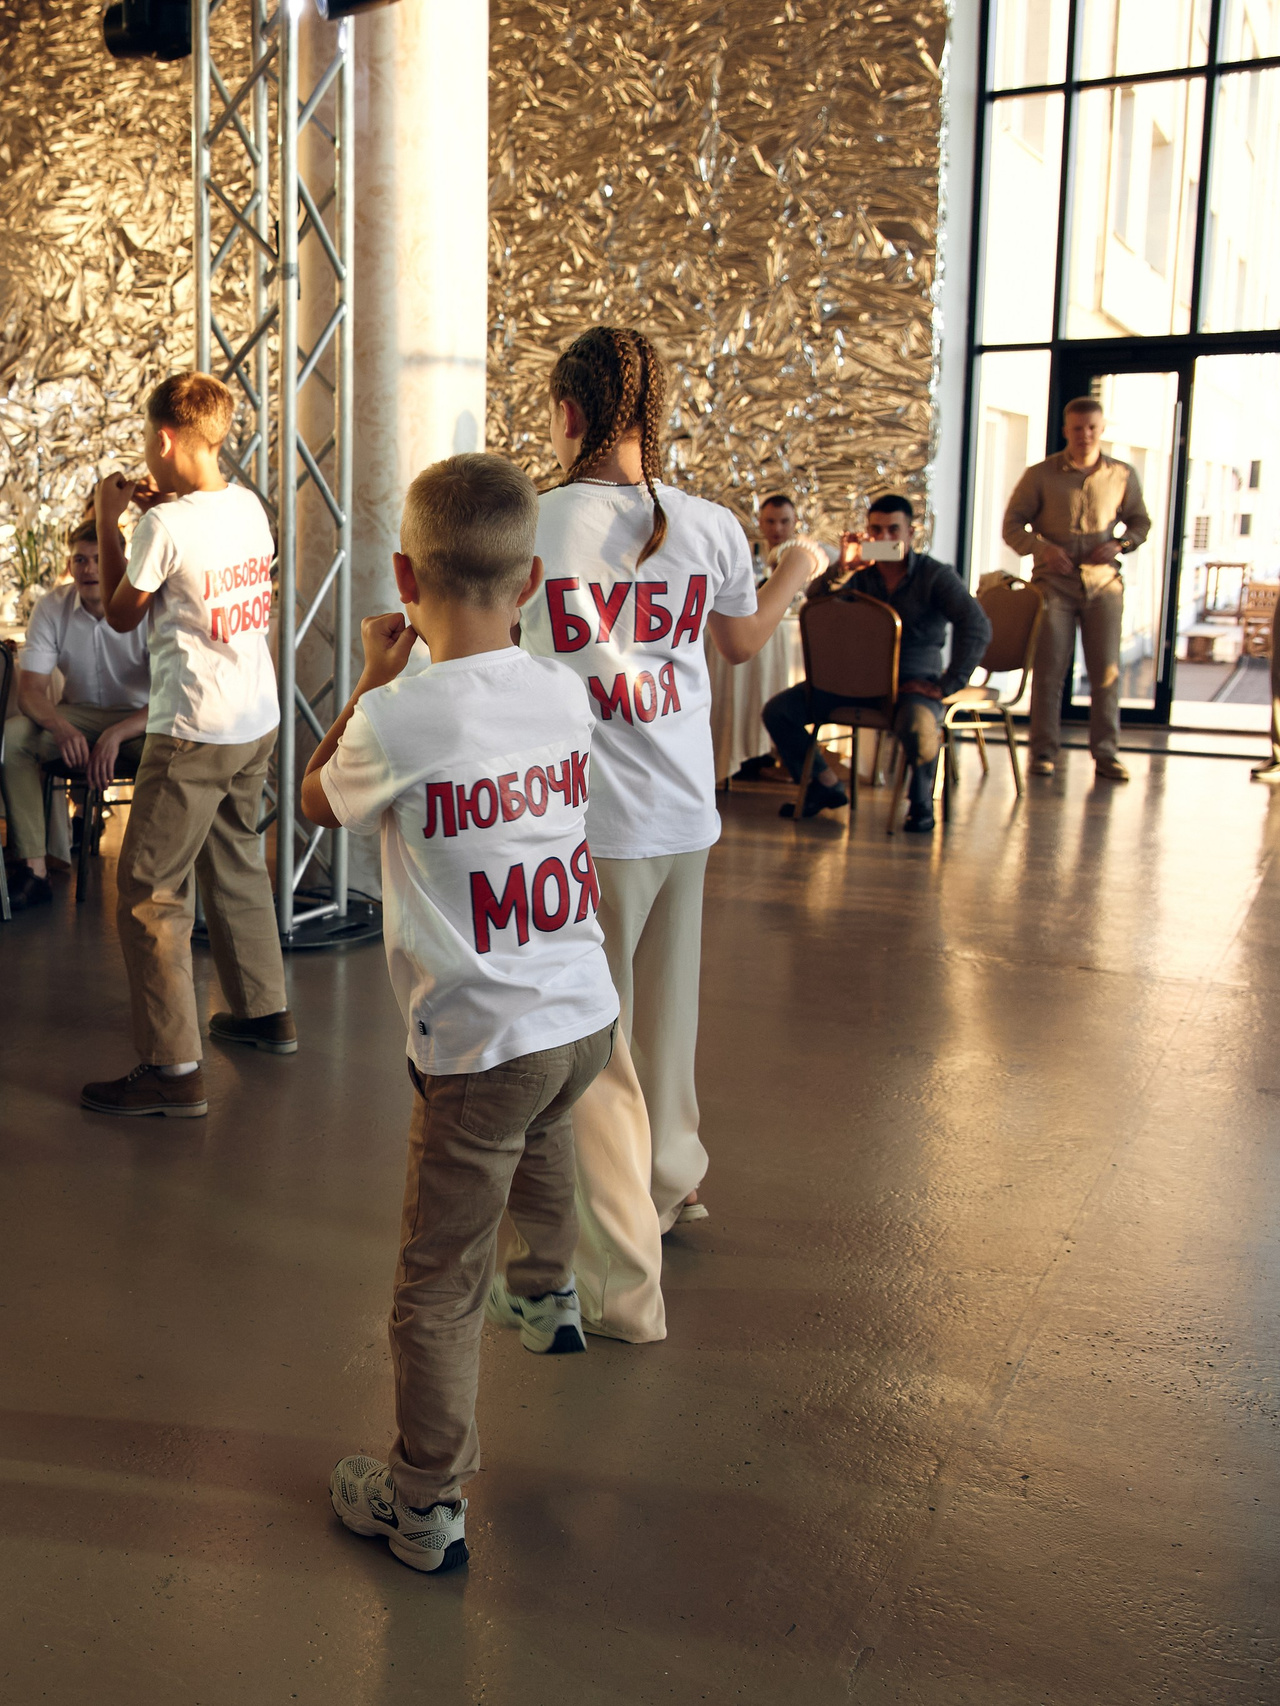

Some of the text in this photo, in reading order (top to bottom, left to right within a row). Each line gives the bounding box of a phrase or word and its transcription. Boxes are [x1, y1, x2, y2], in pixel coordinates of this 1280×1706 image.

[210, 591, 271, 643] ЛЮБОВ
[545, 574, 707, 653] БУБА
[588, 661, 681, 726] МОЯ
[422, 750, 590, 839] ЛЮБОЧК
[469, 838, 600, 954] МОЯ
